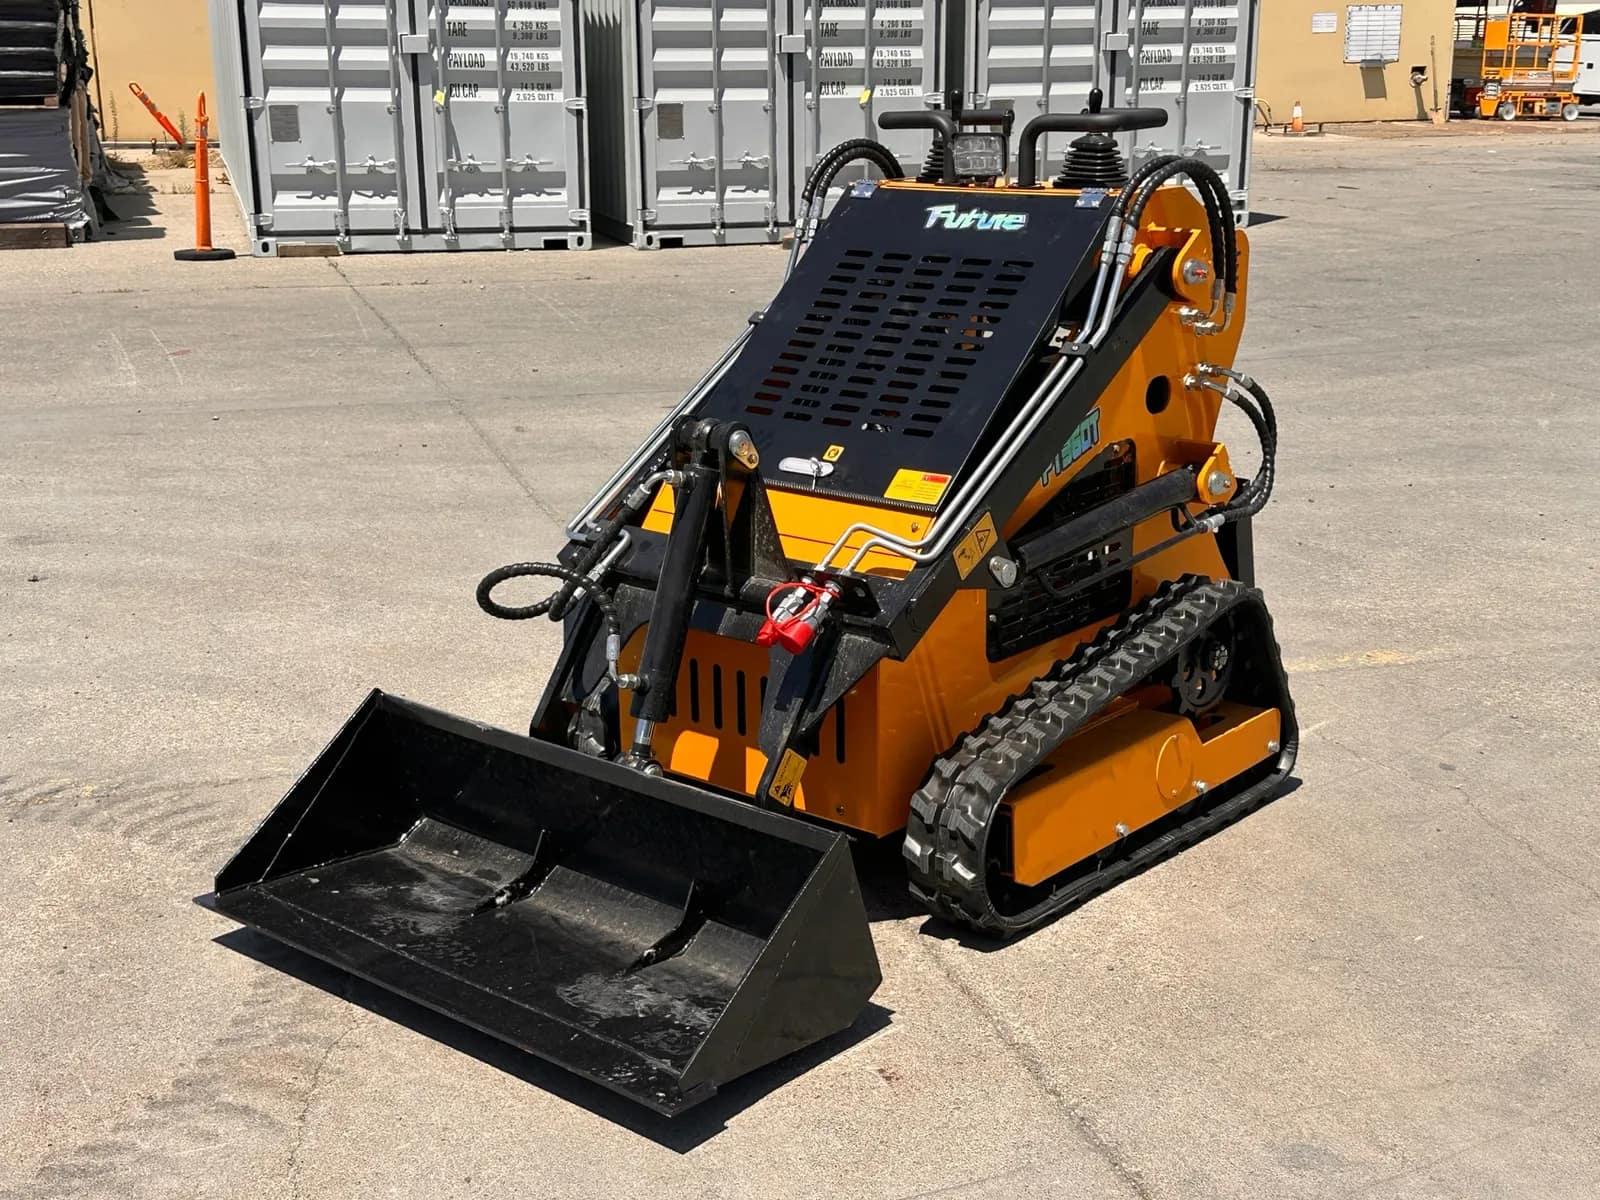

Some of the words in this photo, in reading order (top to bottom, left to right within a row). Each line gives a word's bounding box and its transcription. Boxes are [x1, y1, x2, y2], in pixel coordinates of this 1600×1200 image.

[447, 21, 467, 37] TARE
[536, 21, 548, 30] KGS
[820, 22, 838, 37] TARE
[448, 53, 485, 68] PAYLOAD
[536, 52, 549, 60] KGS
[820, 52, 853, 67] PAYLOAD
[1141, 49, 1172, 64] PAYLOAD
[510, 63, 534, 72] 43,520
[537, 63, 550, 71] LBS
[924, 203, 1028, 231] Future
